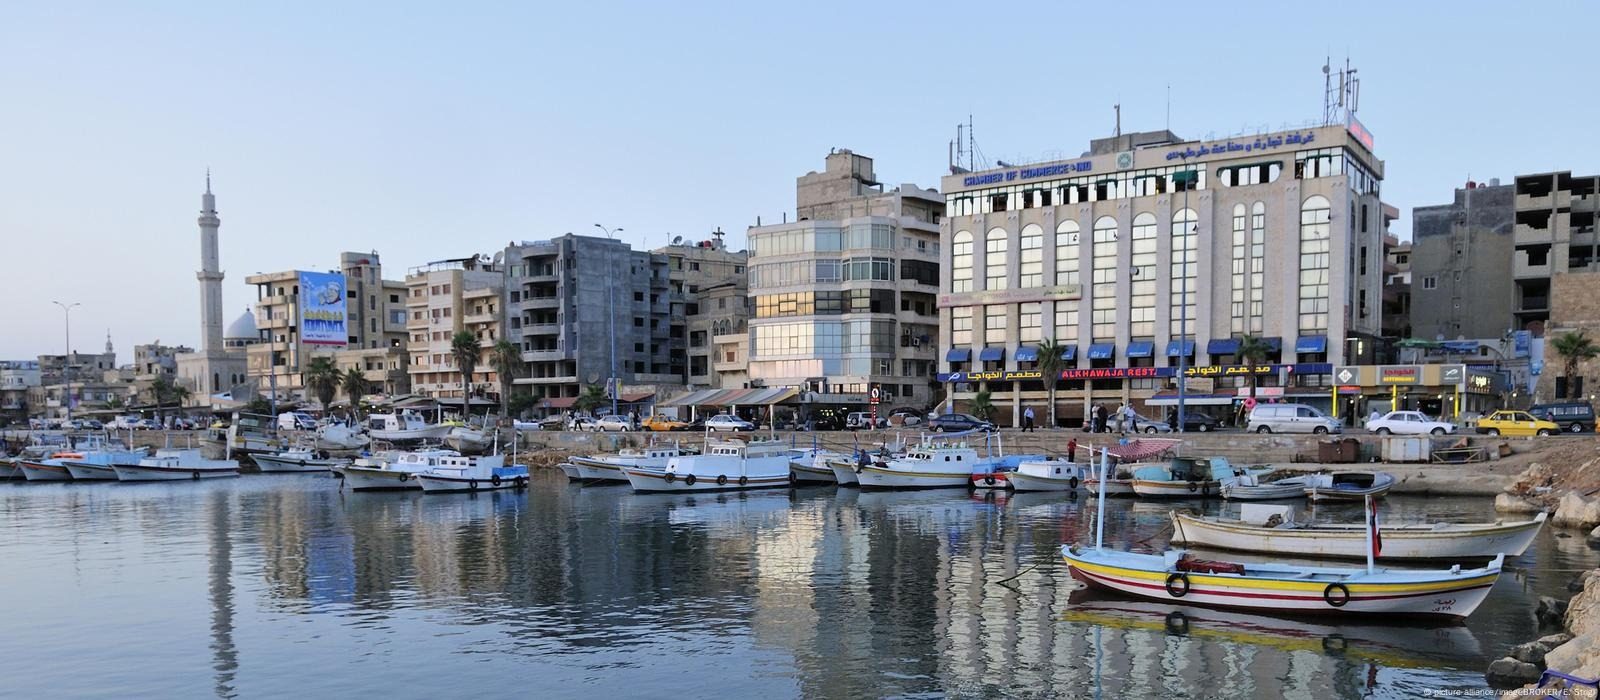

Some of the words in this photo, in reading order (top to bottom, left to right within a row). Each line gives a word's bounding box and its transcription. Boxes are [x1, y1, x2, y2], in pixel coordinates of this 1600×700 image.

[1166, 146, 1210, 161] طرطس
[964, 173, 1003, 187] CHAMBER
[1006, 171, 1018, 181] OF
[1020, 164, 1069, 180] COMMERCE
[967, 372, 1003, 380] الخواجا
[1005, 371, 1042, 380] مطعم
[1062, 369, 1124, 379] ALKHAWAJA
